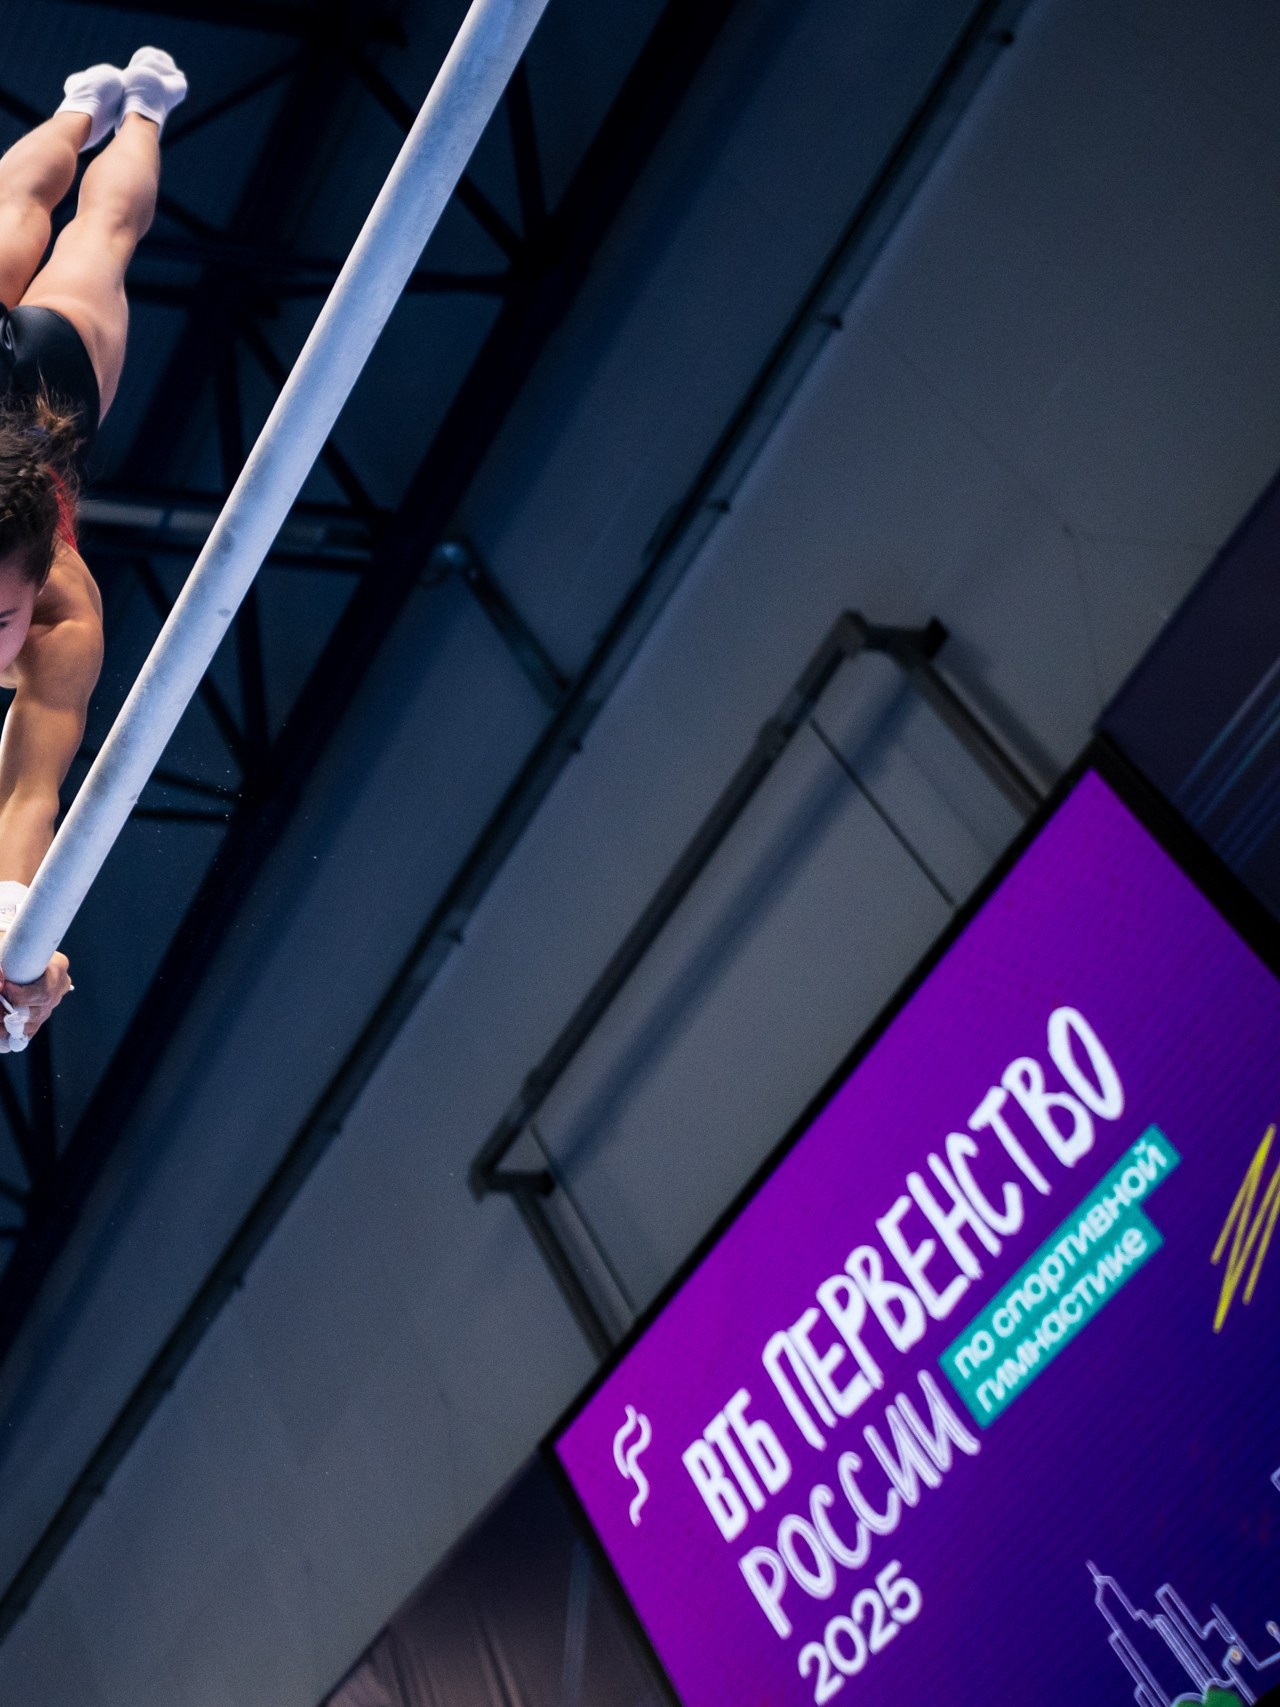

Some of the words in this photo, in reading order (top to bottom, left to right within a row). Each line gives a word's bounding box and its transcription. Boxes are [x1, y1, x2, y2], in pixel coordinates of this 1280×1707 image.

[681, 1387, 791, 1542] ВТБ
[761, 1006, 1124, 1450] ПЕРВЕНСТВО
[738, 1369, 981, 1640] РОССИИ
[797, 1559, 922, 1705] 2025
